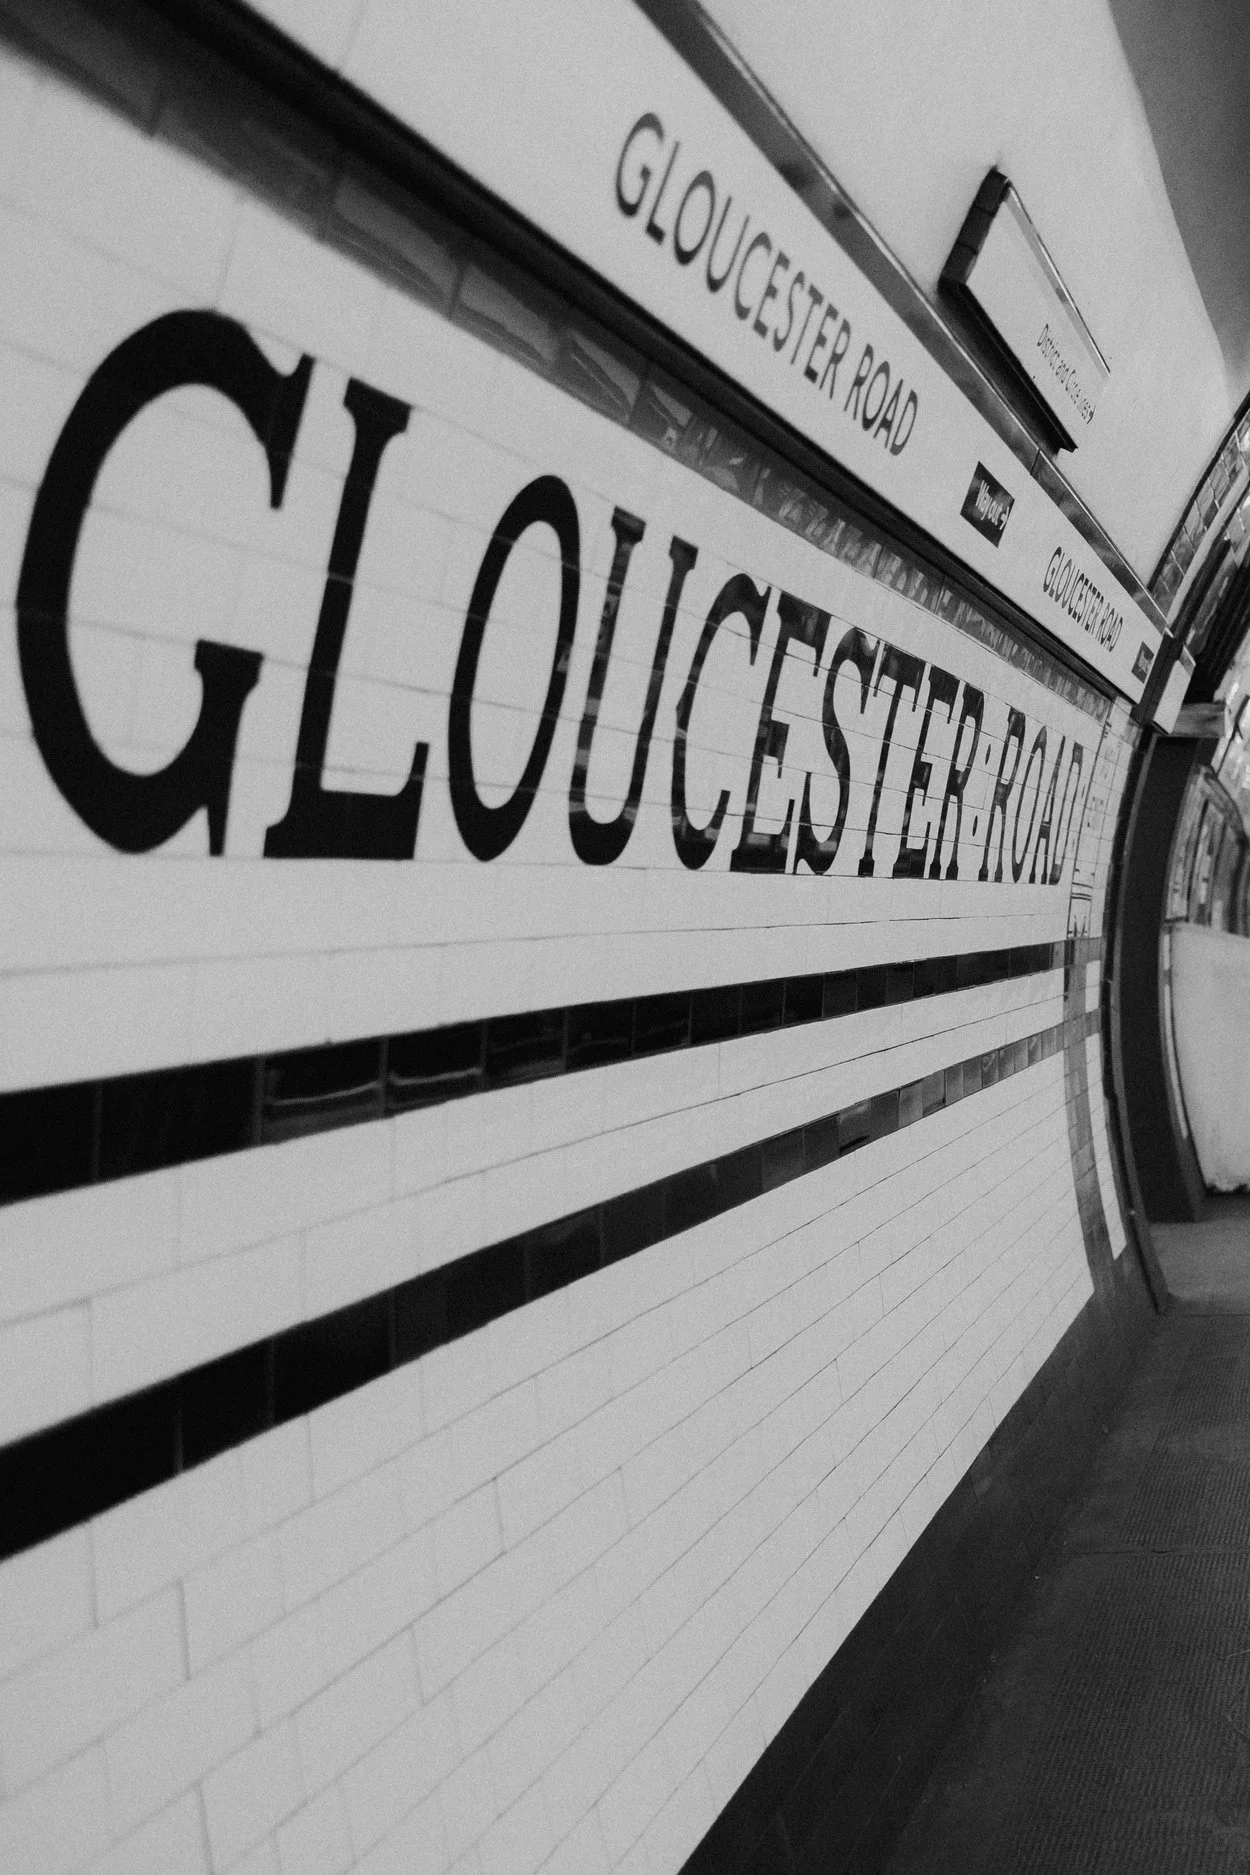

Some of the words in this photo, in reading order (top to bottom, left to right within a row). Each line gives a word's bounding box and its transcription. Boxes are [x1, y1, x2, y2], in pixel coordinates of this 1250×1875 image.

[615, 112, 851, 400] GLOUCESTER
[844, 343, 919, 456] ROAD
[975, 479, 993, 521] Way
[987, 500, 1003, 526] out
[1043, 546, 1104, 636] GLOUCESTER
[1095, 602, 1123, 653] ROAD
